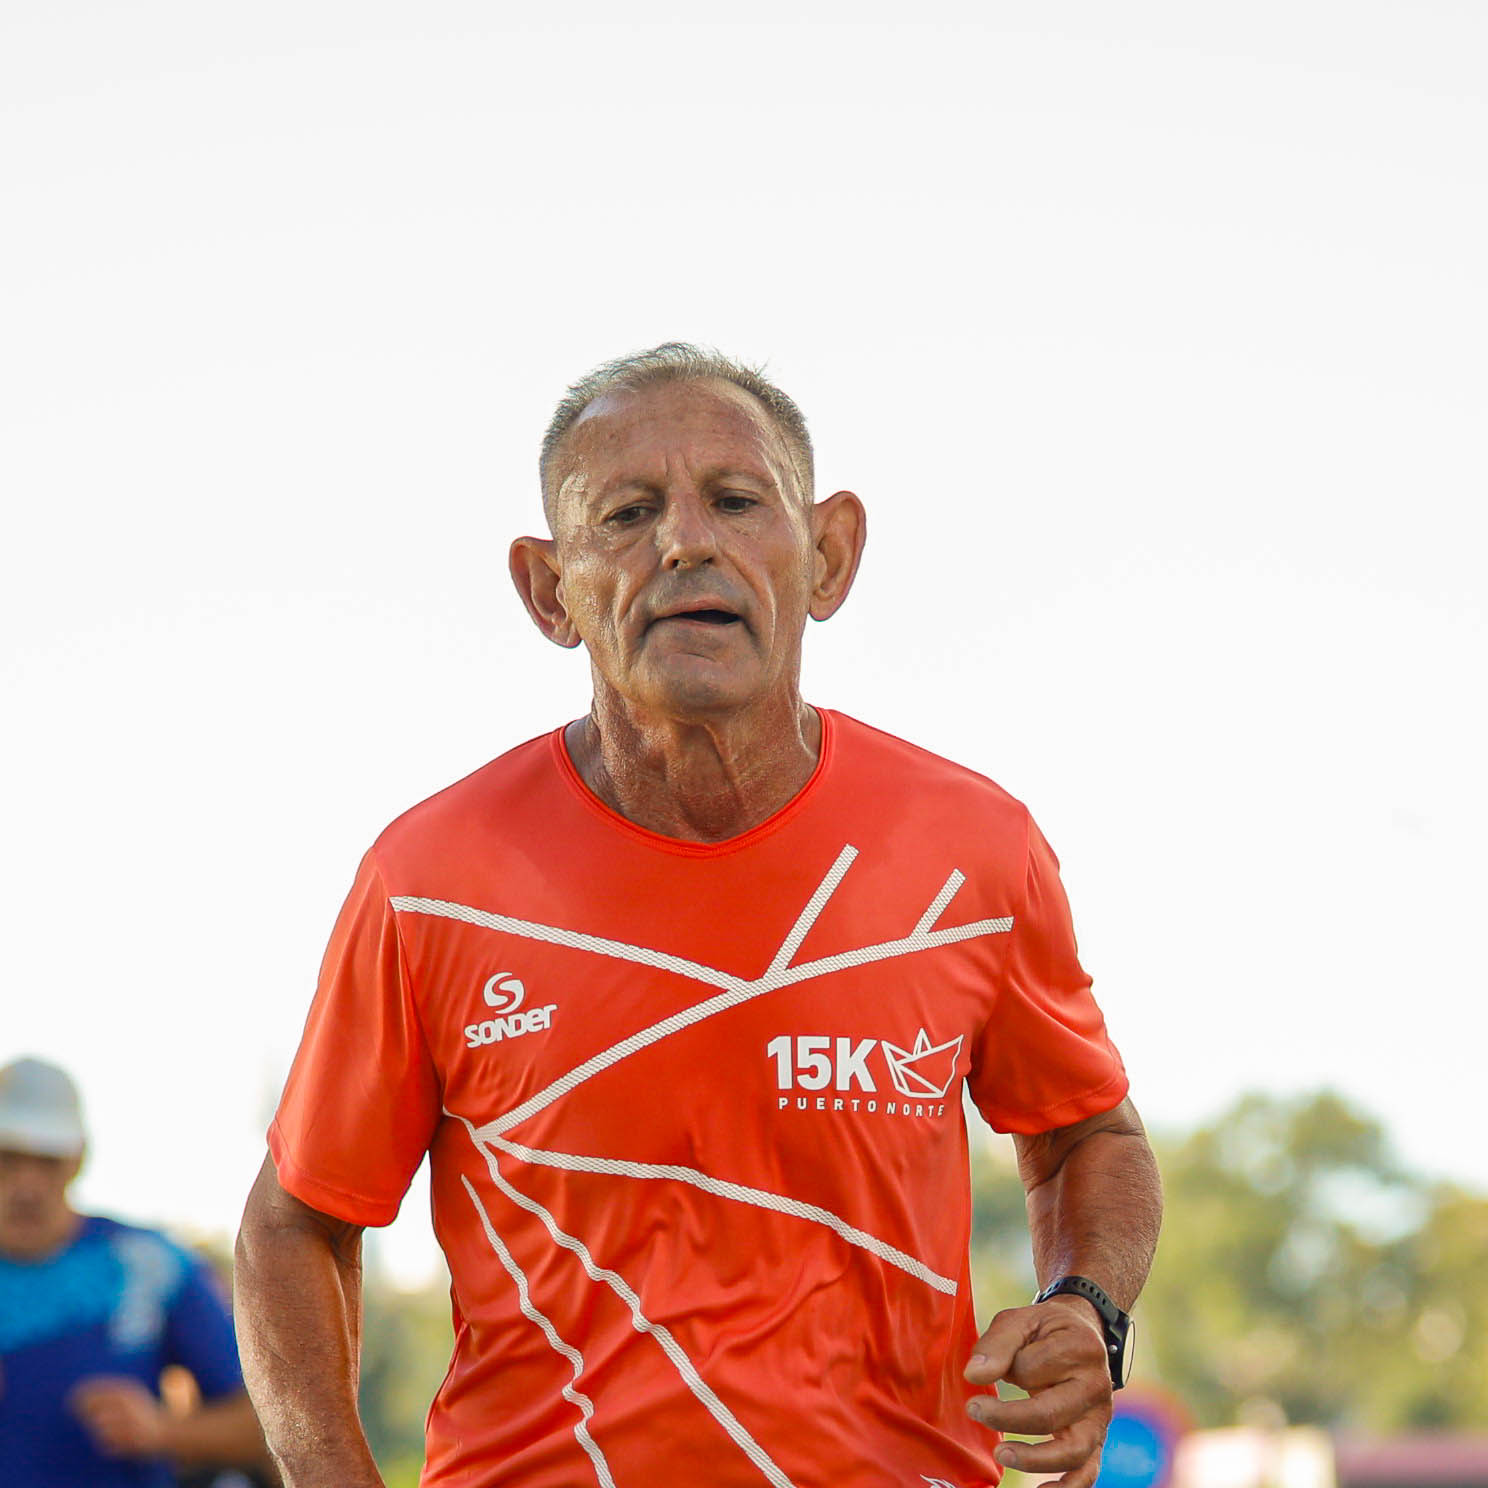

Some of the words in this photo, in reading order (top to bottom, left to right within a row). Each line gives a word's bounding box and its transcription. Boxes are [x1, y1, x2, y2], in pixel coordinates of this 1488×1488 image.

[767, 1036, 877, 1093] 15K
[778, 1097, 877, 1112] PUERTO
[886, 1102, 945, 1117] NORTE
